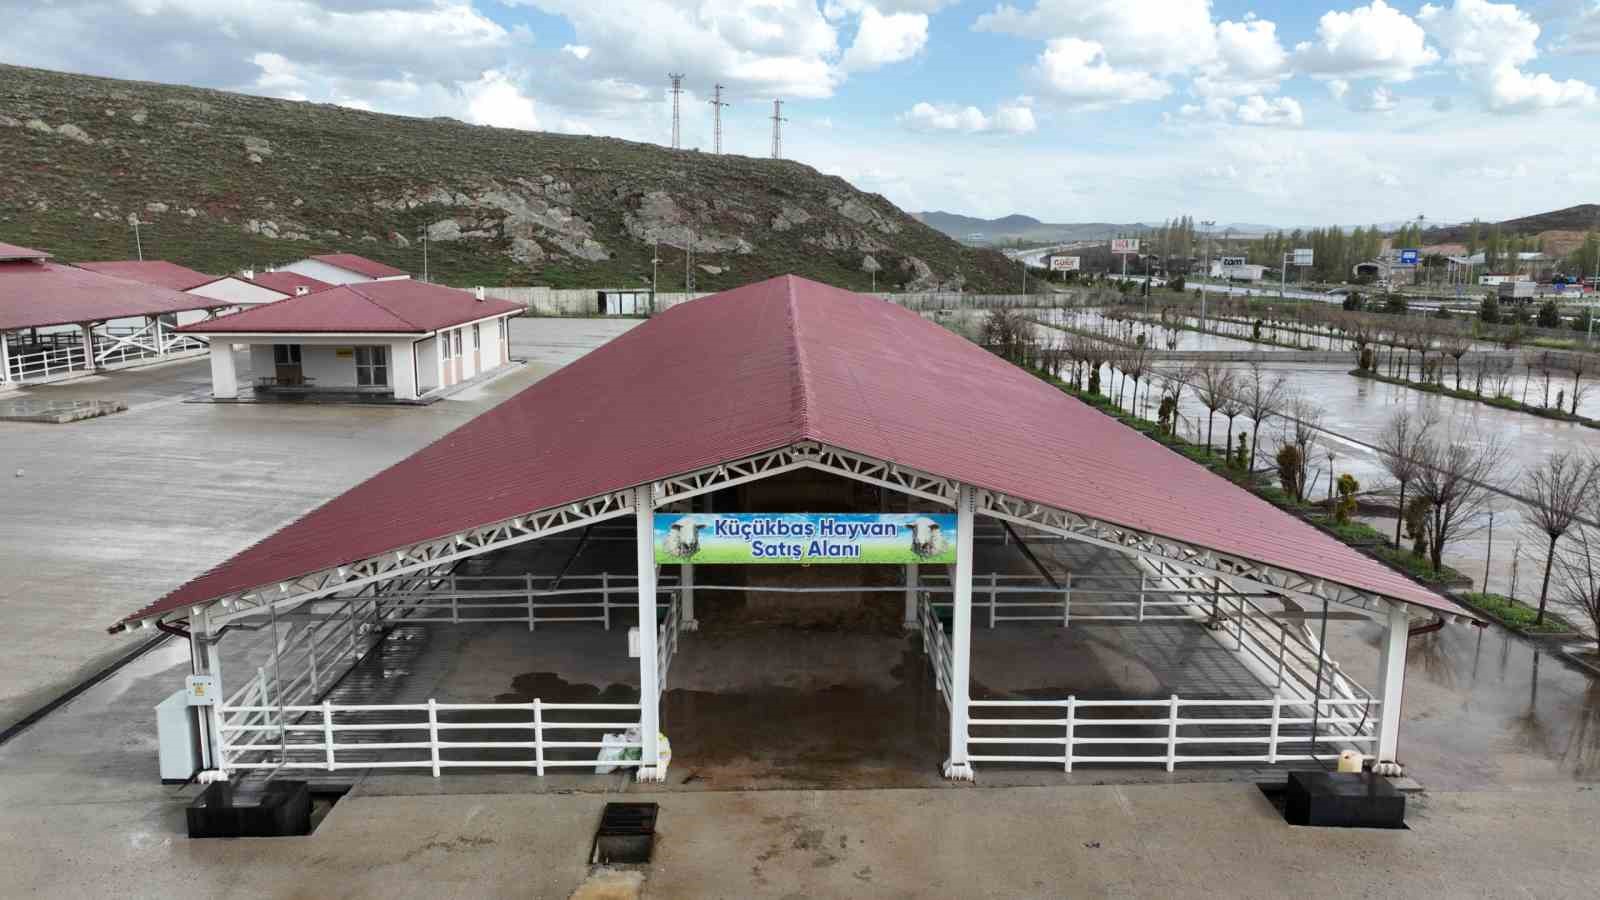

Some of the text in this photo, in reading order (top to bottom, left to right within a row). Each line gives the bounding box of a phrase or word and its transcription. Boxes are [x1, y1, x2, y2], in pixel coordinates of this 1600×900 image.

[715, 519, 897, 540] Küçükbaş Hayvan
[752, 541, 860, 559] Satış Alanı
